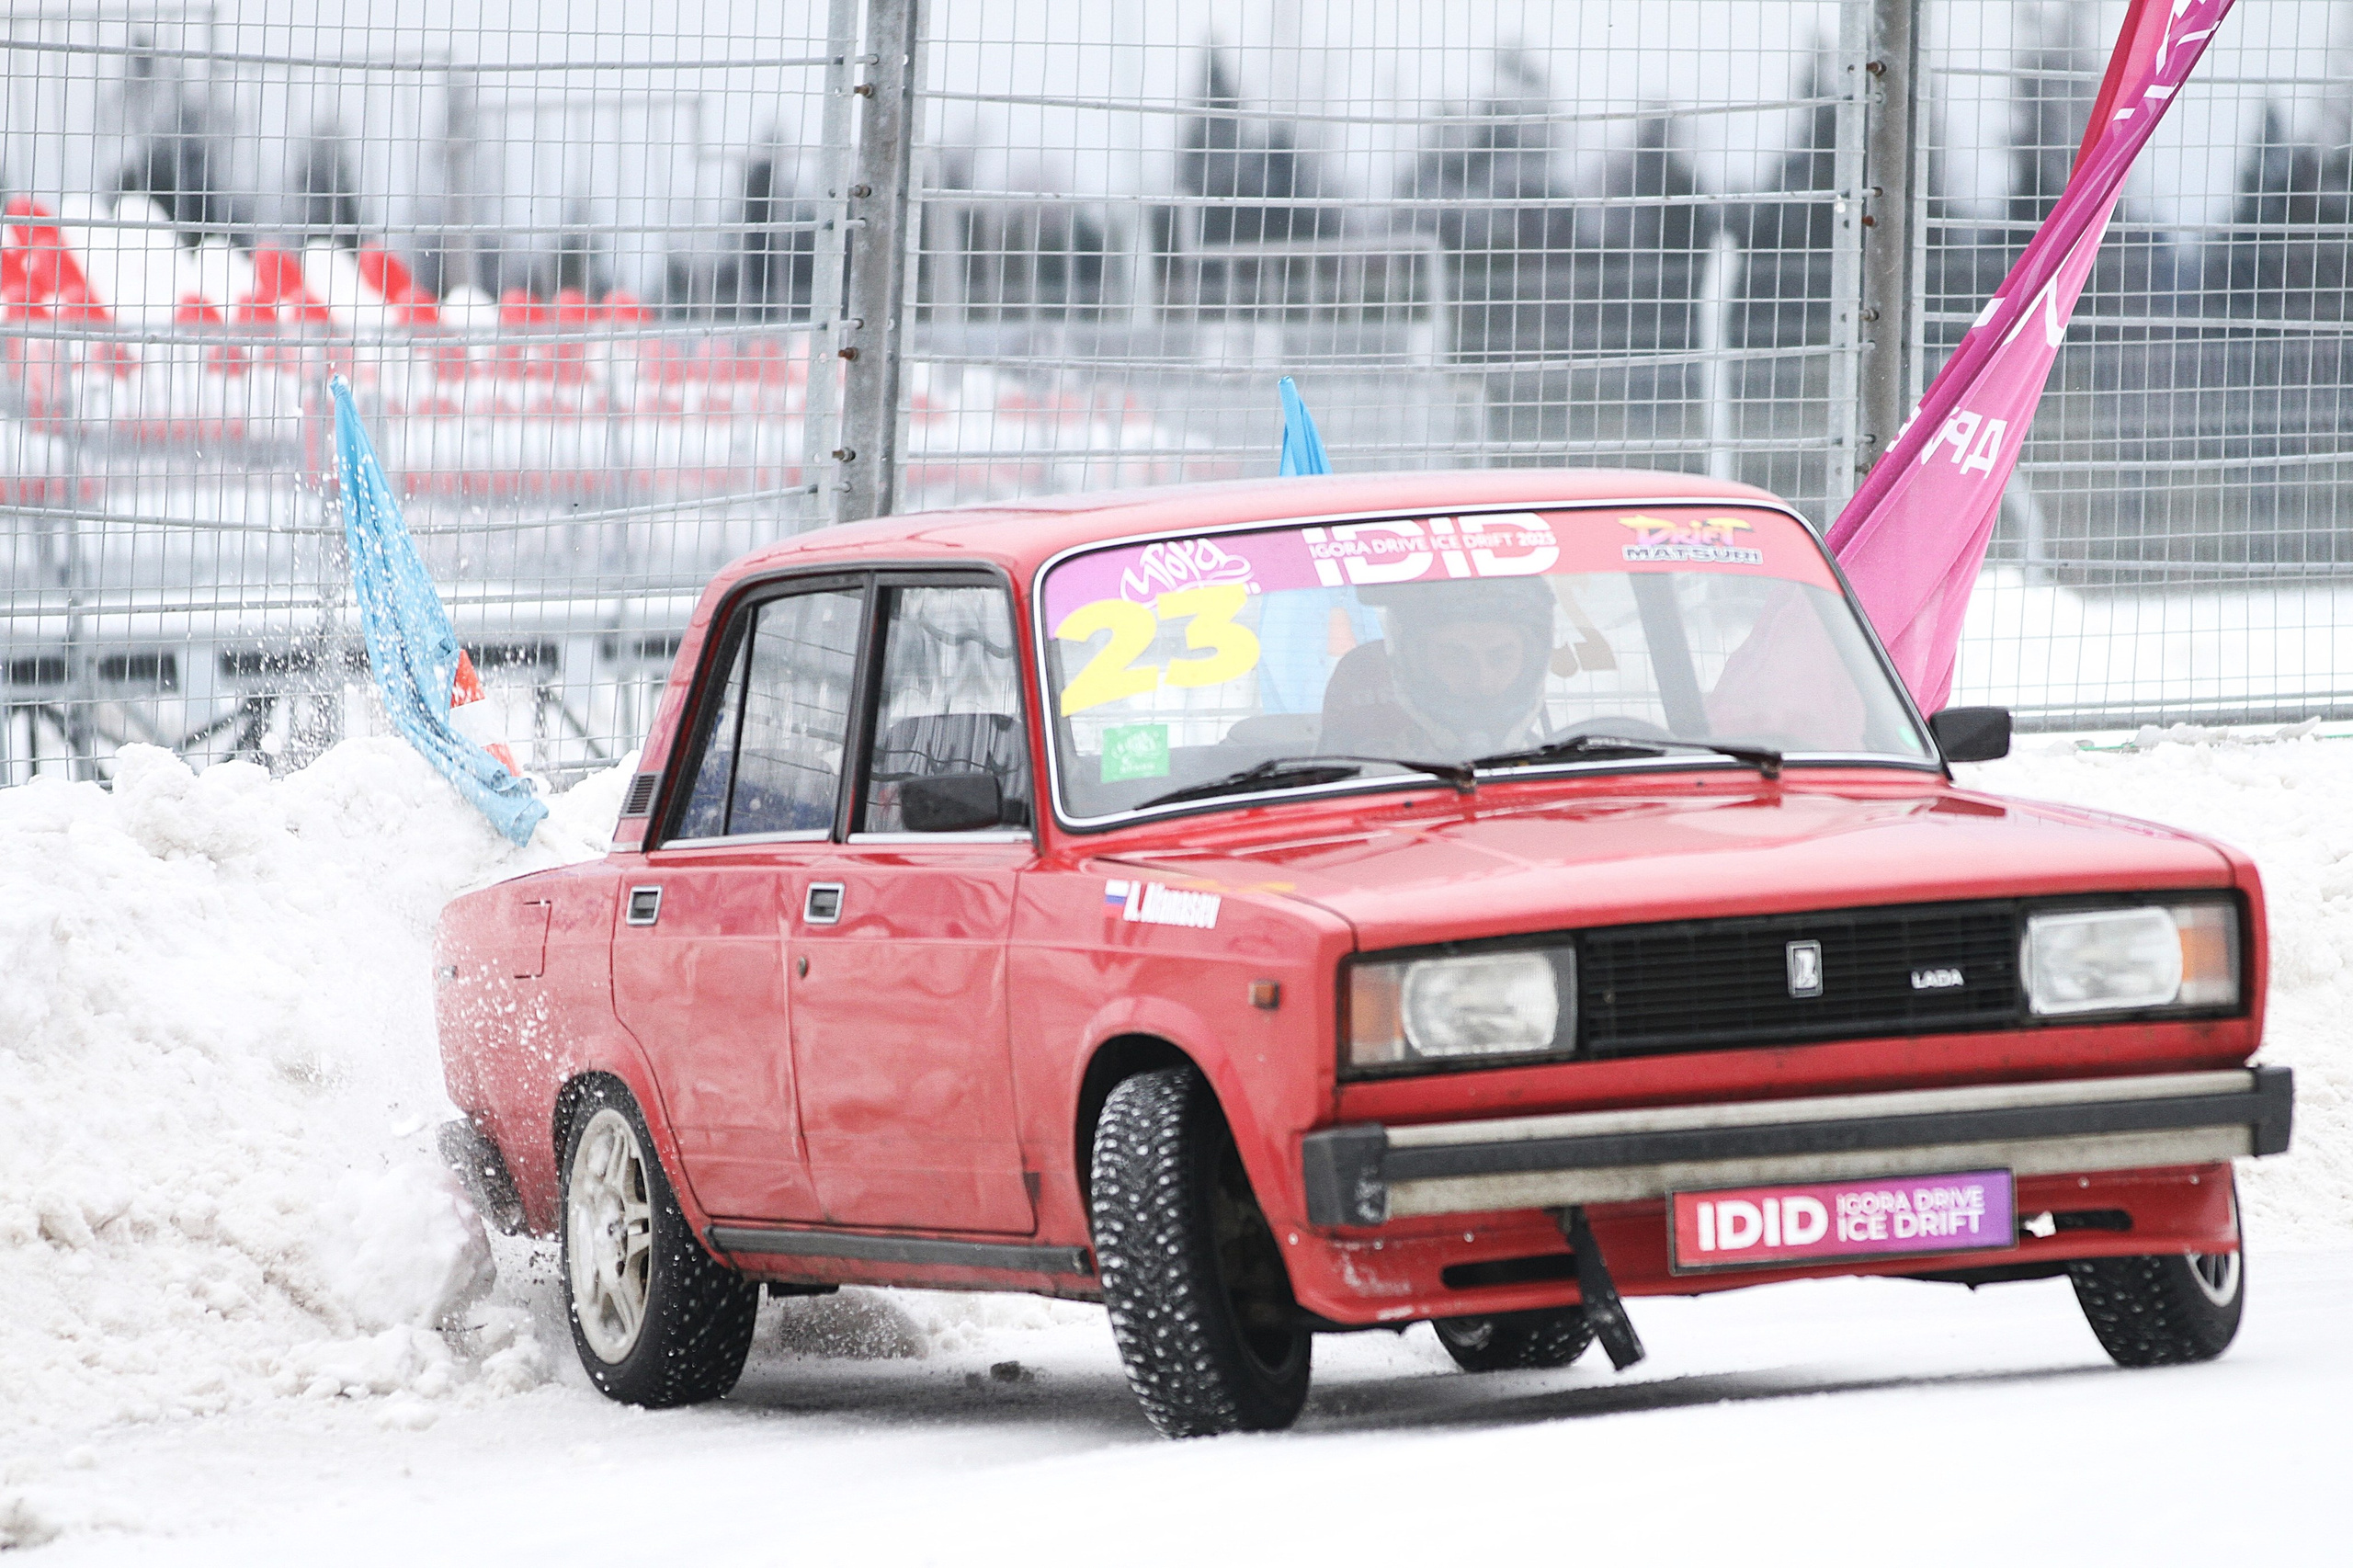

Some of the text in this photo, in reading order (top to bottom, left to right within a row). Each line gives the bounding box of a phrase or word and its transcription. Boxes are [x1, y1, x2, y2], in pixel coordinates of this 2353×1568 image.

[1302, 512, 1560, 586] IDID
[1309, 539, 1370, 559] IGORA
[1371, 536, 1428, 553] DRIVE
[1430, 533, 1460, 551] ICE
[1463, 532, 1514, 549] DRIFT
[1623, 545, 1763, 564] MATSURI
[1054, 583, 1261, 718] 23
[1911, 968, 1965, 990] LADA
[1836, 1185, 1985, 1216] IGORA DRIVE
[1697, 1196, 1830, 1251] IDID
[1837, 1210, 1985, 1242] ICE DRIFT
